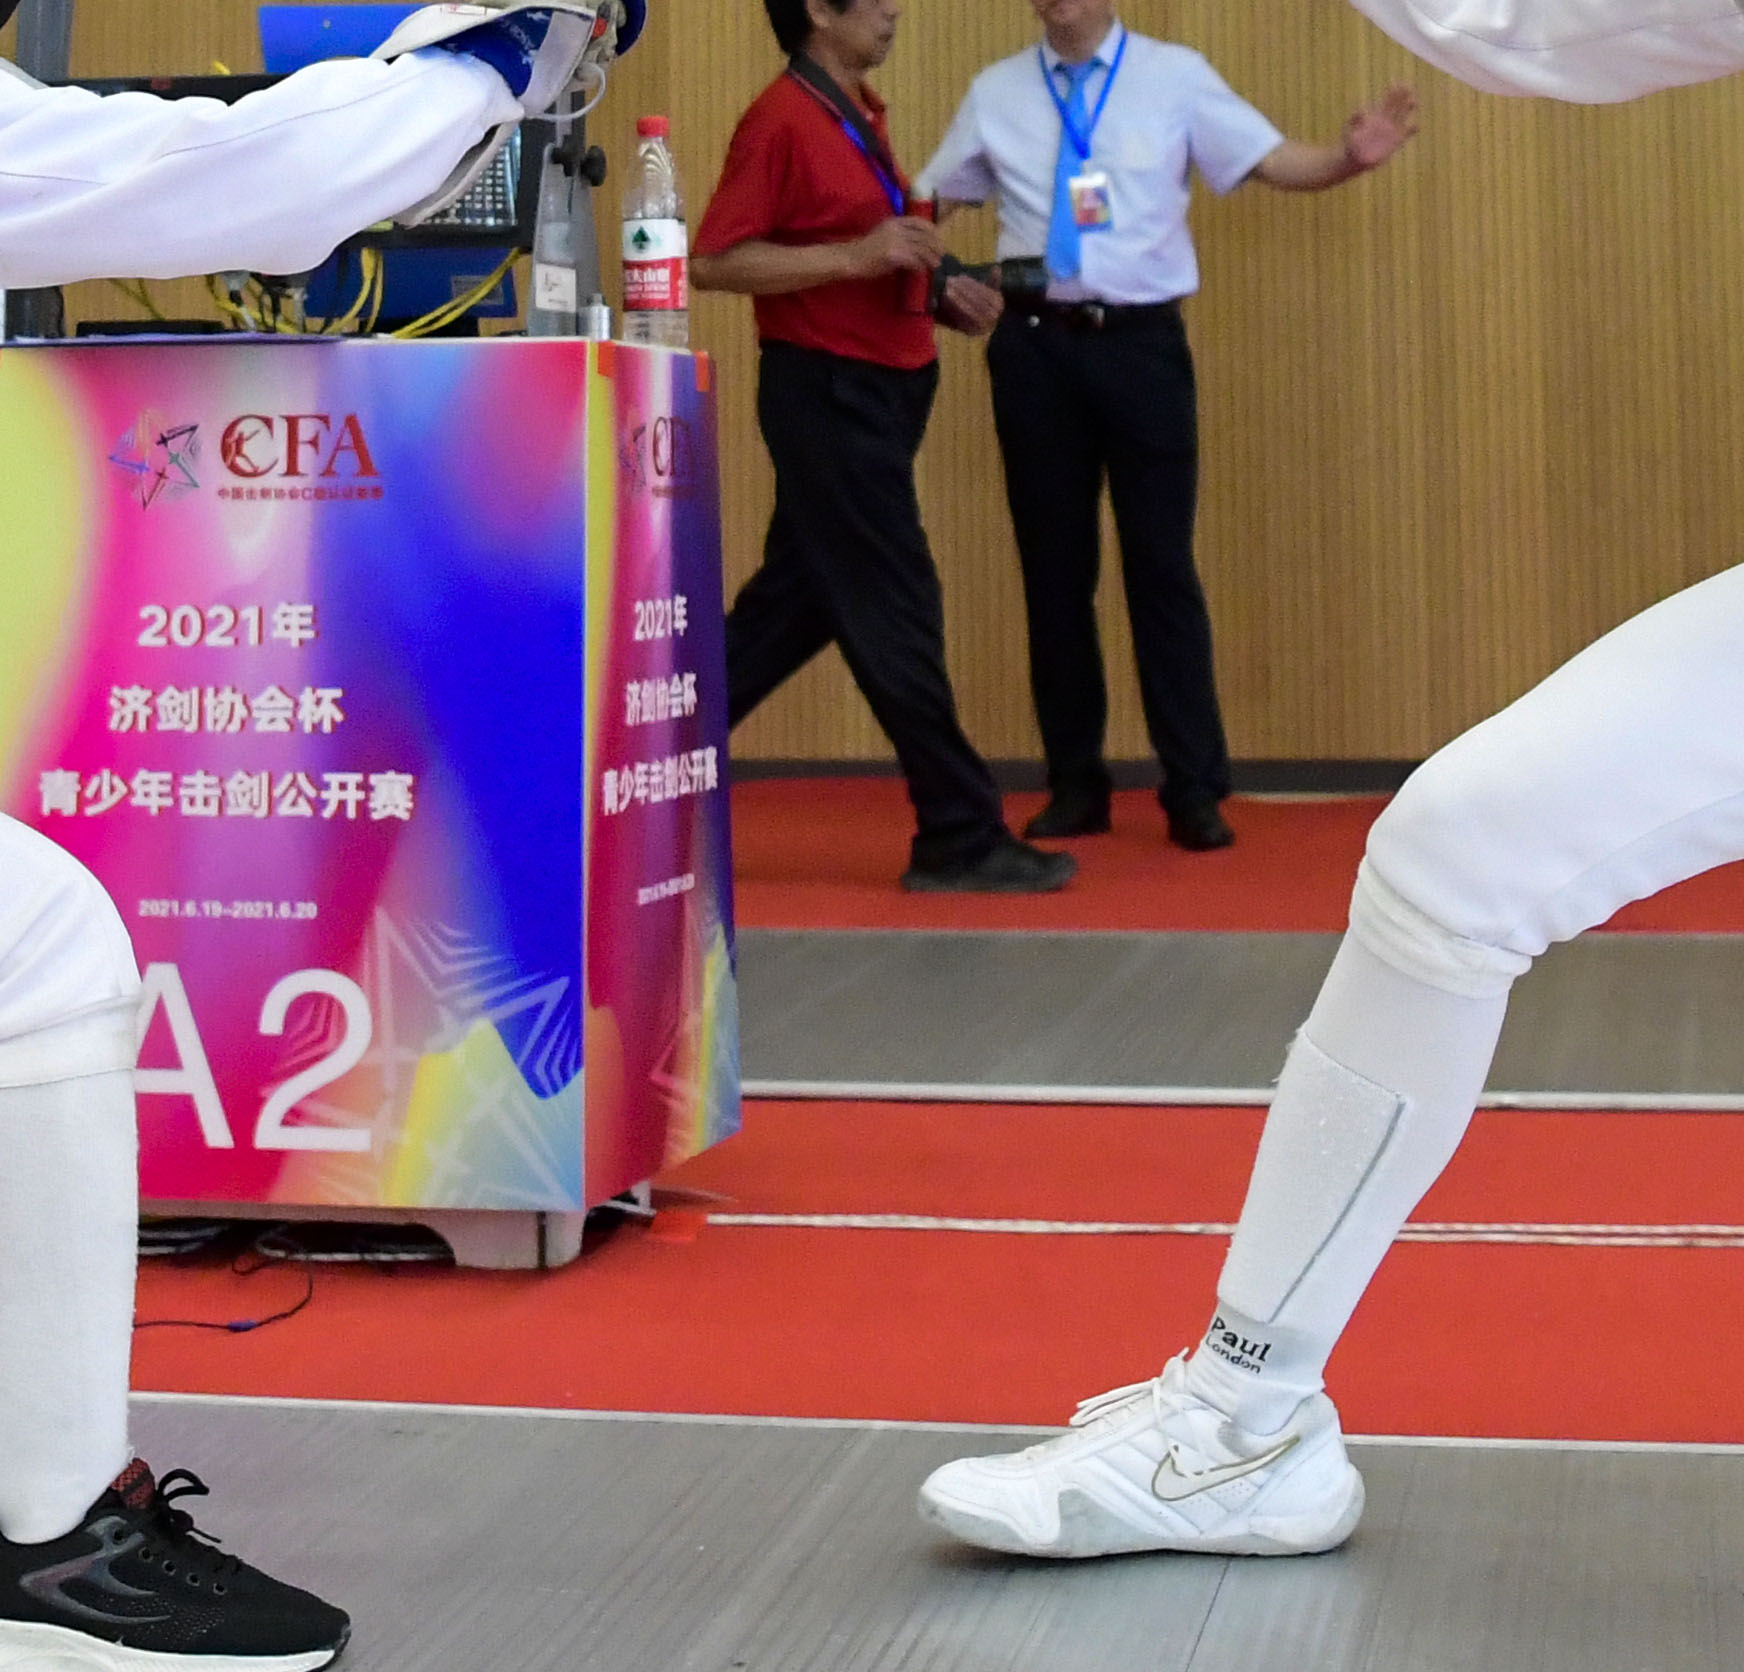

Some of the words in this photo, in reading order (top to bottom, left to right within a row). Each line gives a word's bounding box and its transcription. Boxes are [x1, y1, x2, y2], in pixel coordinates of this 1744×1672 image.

[219, 412, 381, 478] CFA
[138, 601, 318, 648] 2021年
[633, 593, 688, 641] 2021年
[109, 684, 345, 734] 济剑协会杯
[39, 768, 416, 822] 青少年击剑公开赛
[132, 959, 373, 1151] A2
[1211, 1317, 1272, 1362] Paul
